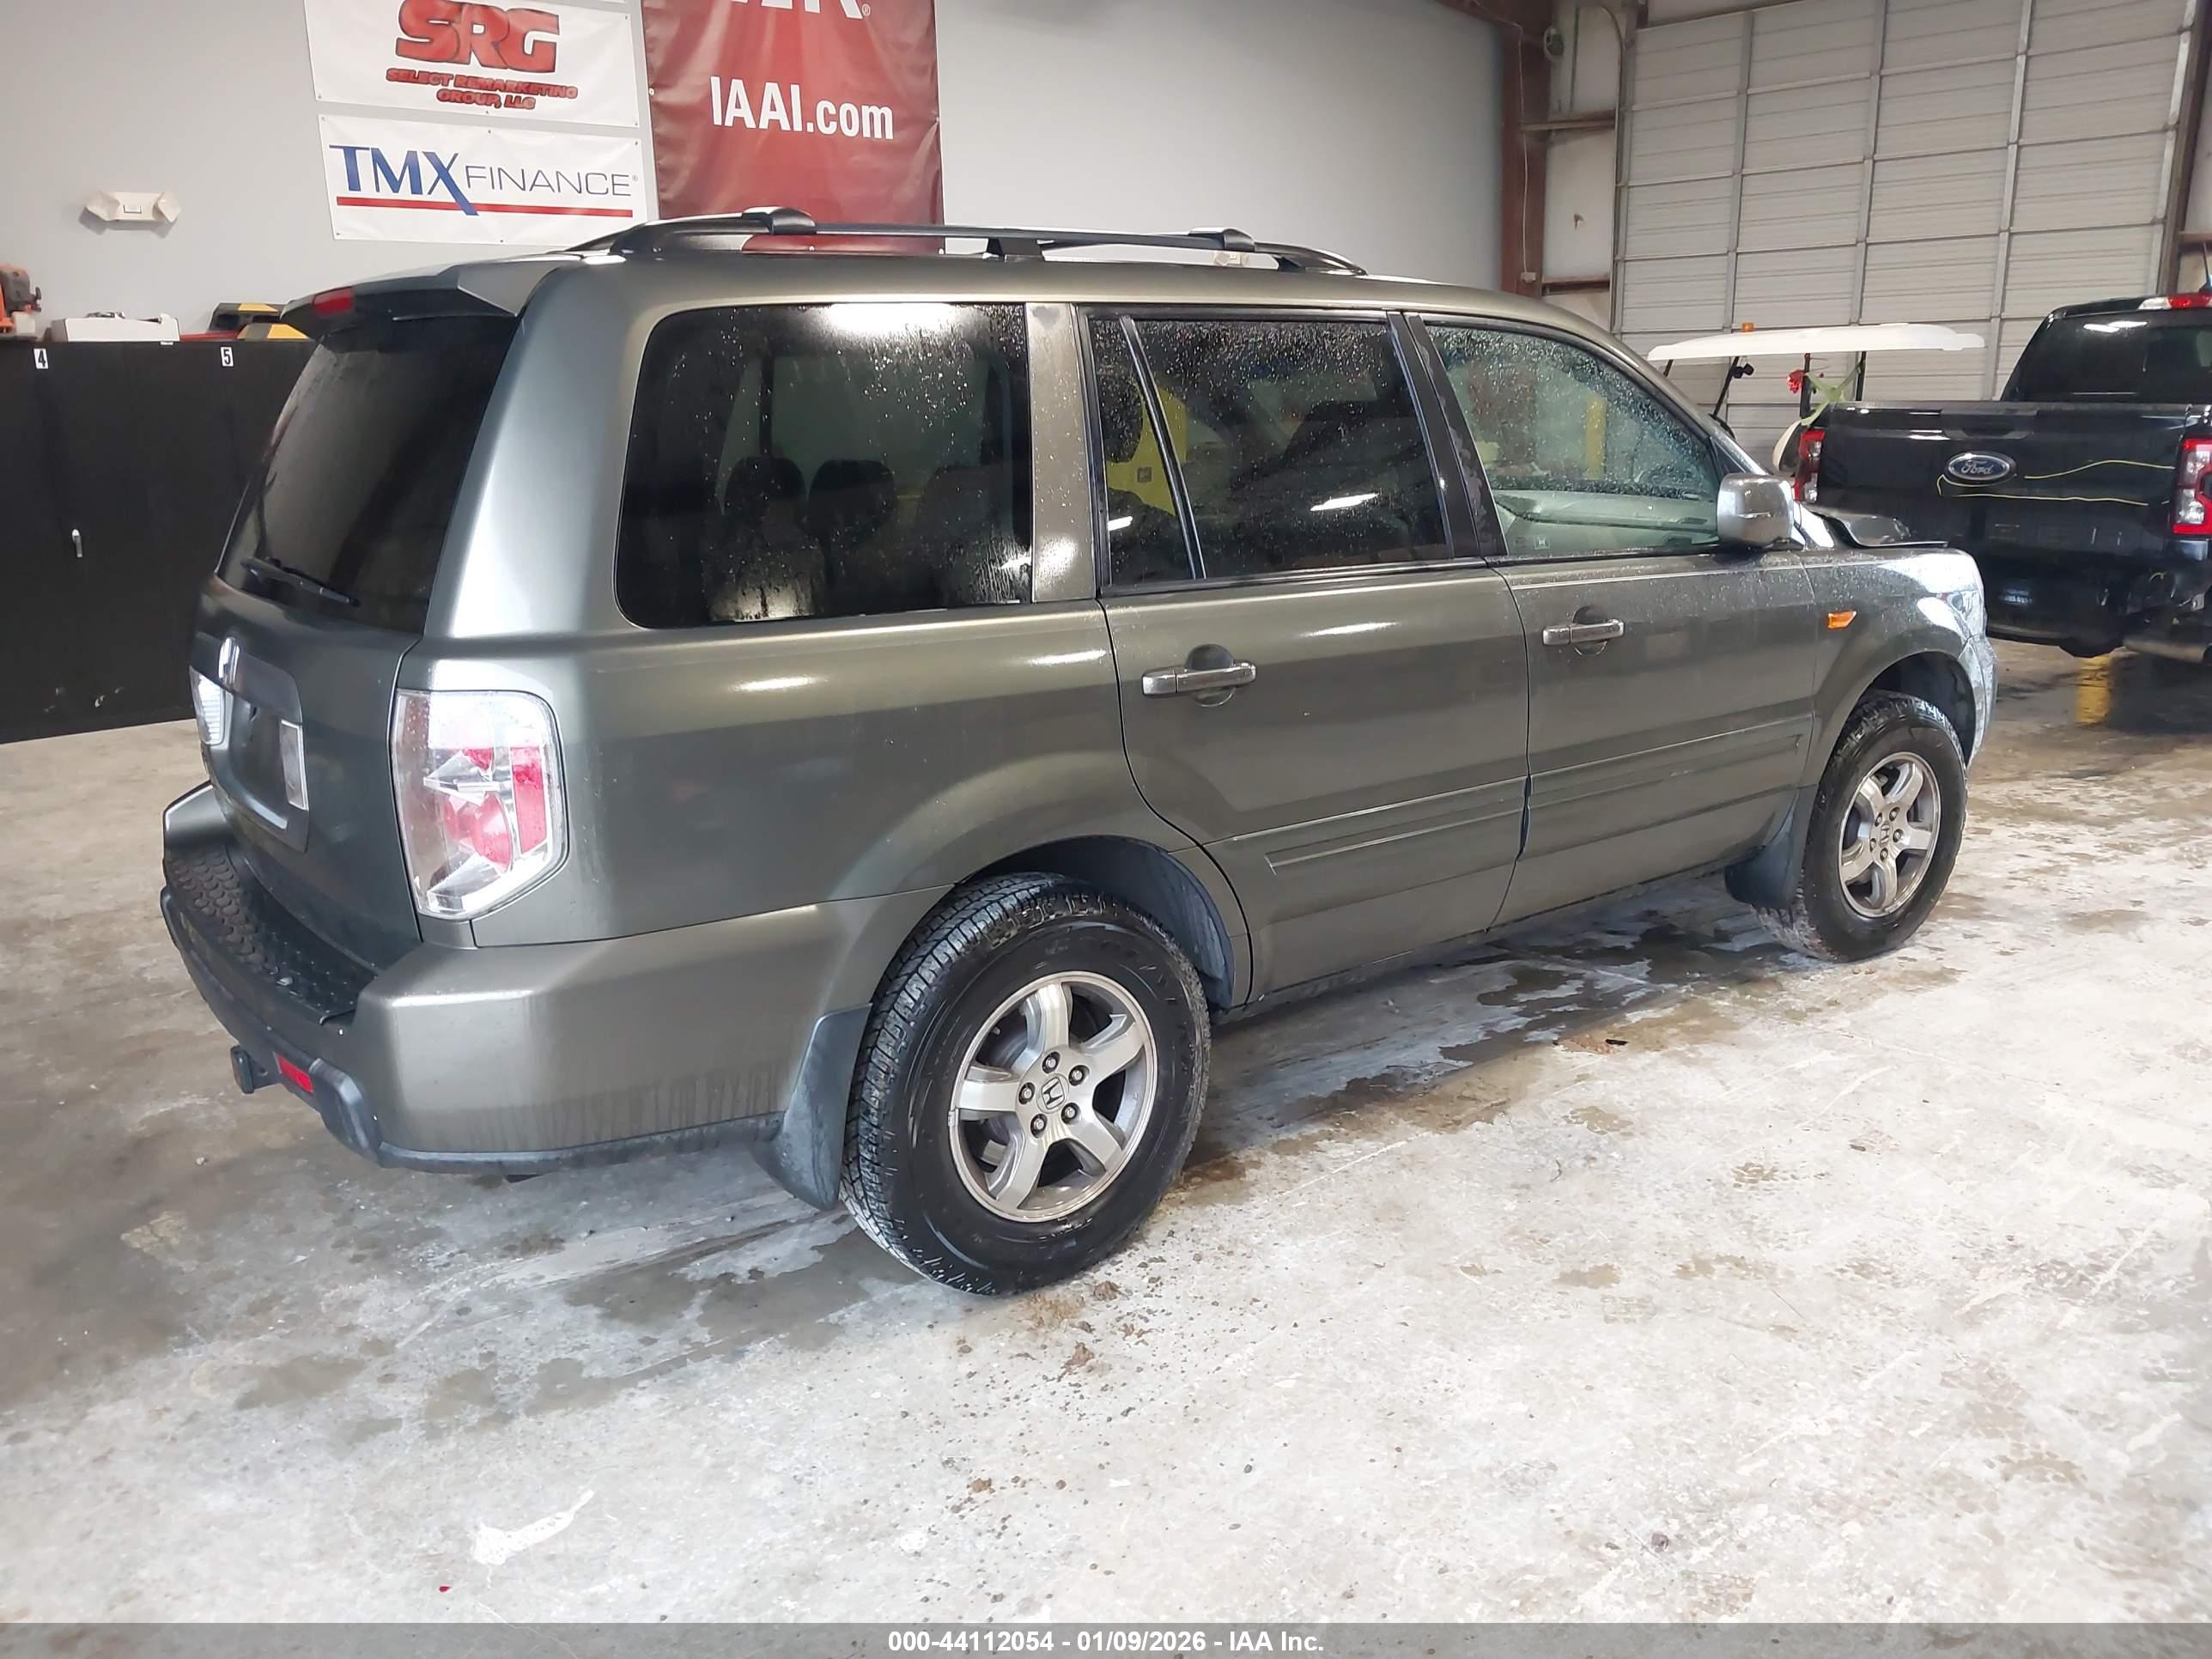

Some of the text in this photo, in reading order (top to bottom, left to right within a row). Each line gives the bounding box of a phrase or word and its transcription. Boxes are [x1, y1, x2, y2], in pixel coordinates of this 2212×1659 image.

[395, 0, 560, 73] SRG
[386, 68, 579, 100] SELECT REMARKETING
[436, 88, 537, 110] GROUP, LLC
[709, 76, 894, 140] IAAI.com
[329, 144, 479, 216] TMX
[38, 349, 46, 368] 4
[223, 349, 231, 365] 5
[1961, 459, 1994, 475] Ford
